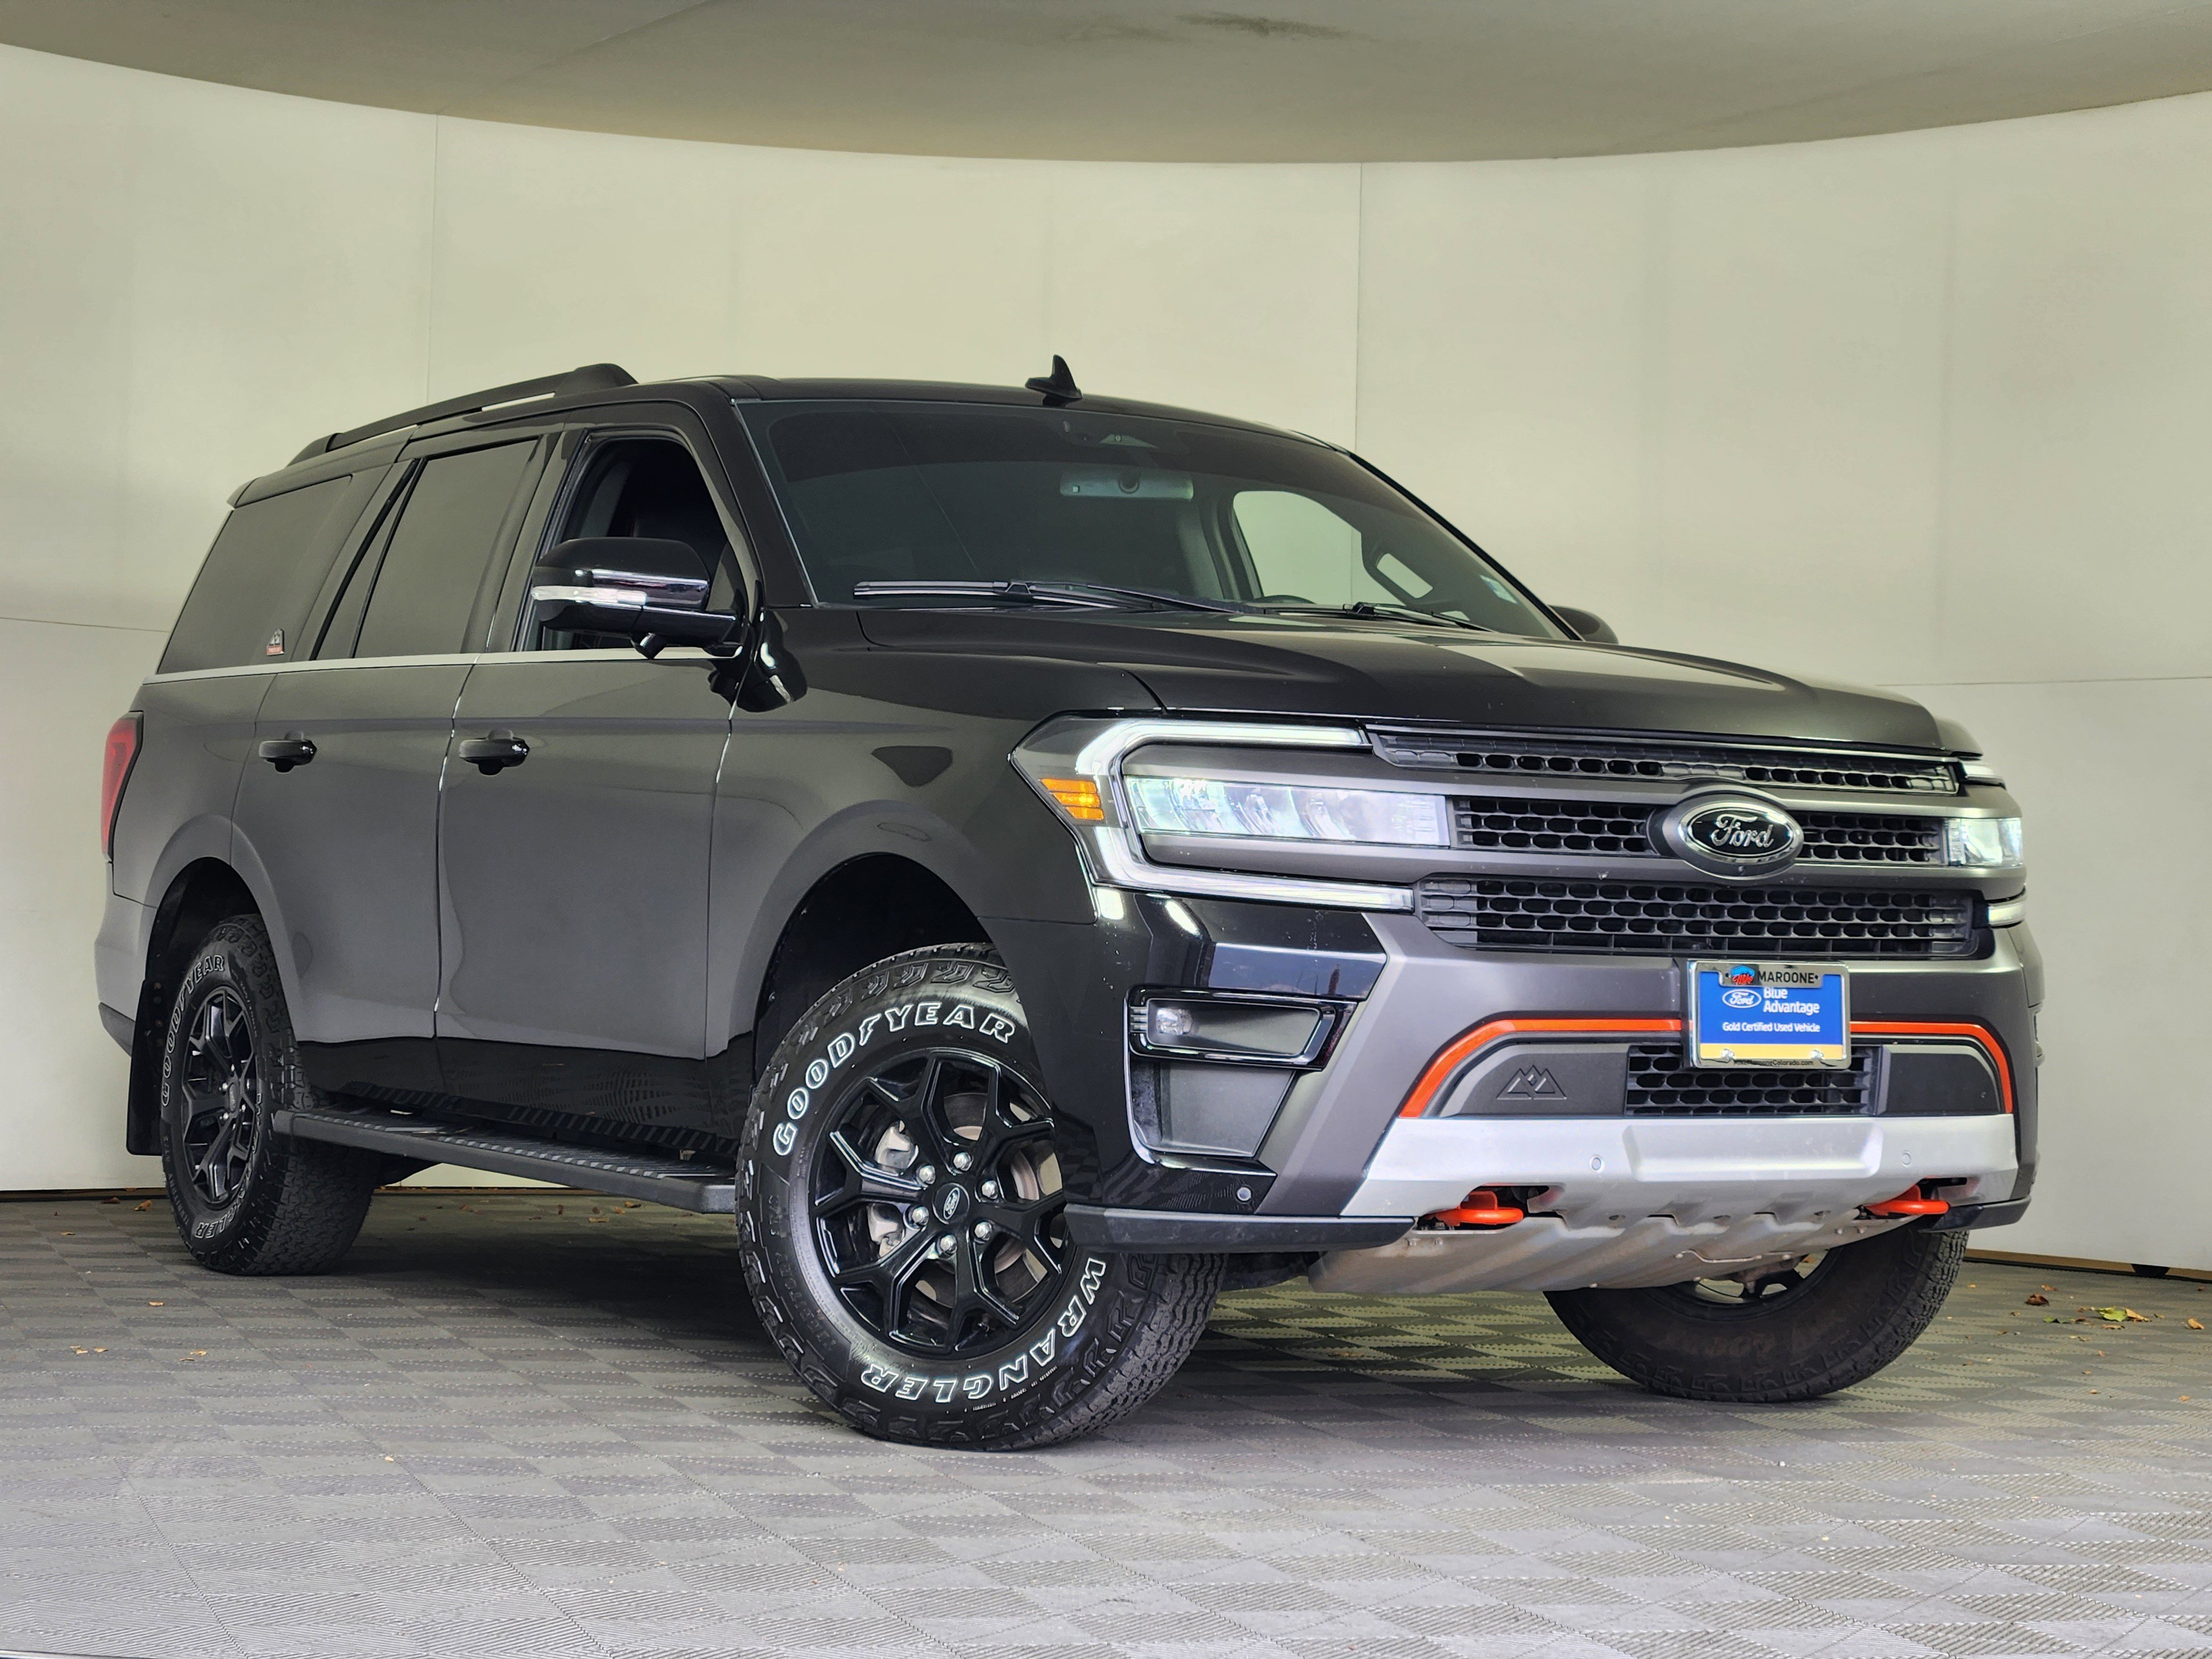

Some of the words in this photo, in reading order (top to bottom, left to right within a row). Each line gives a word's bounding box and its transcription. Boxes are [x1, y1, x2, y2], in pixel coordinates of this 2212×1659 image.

[1710, 813, 1773, 848] Ford
[1757, 971, 1815, 984] MAROONE
[1729, 992, 1755, 1005] Ford
[1762, 987, 1788, 999] Blue
[1762, 1000, 1820, 1015] Advantage
[161, 954, 224, 1107] GOODYEAR
[1722, 1021, 1741, 1032] Gold
[1741, 1021, 1773, 1032] Certified
[1773, 1022, 1793, 1032] Used
[1794, 1022, 1820, 1032] Vehicle
[773, 1001, 1016, 1156] GOODYEAR
[860, 1257, 1107, 1403] WRANGLER
